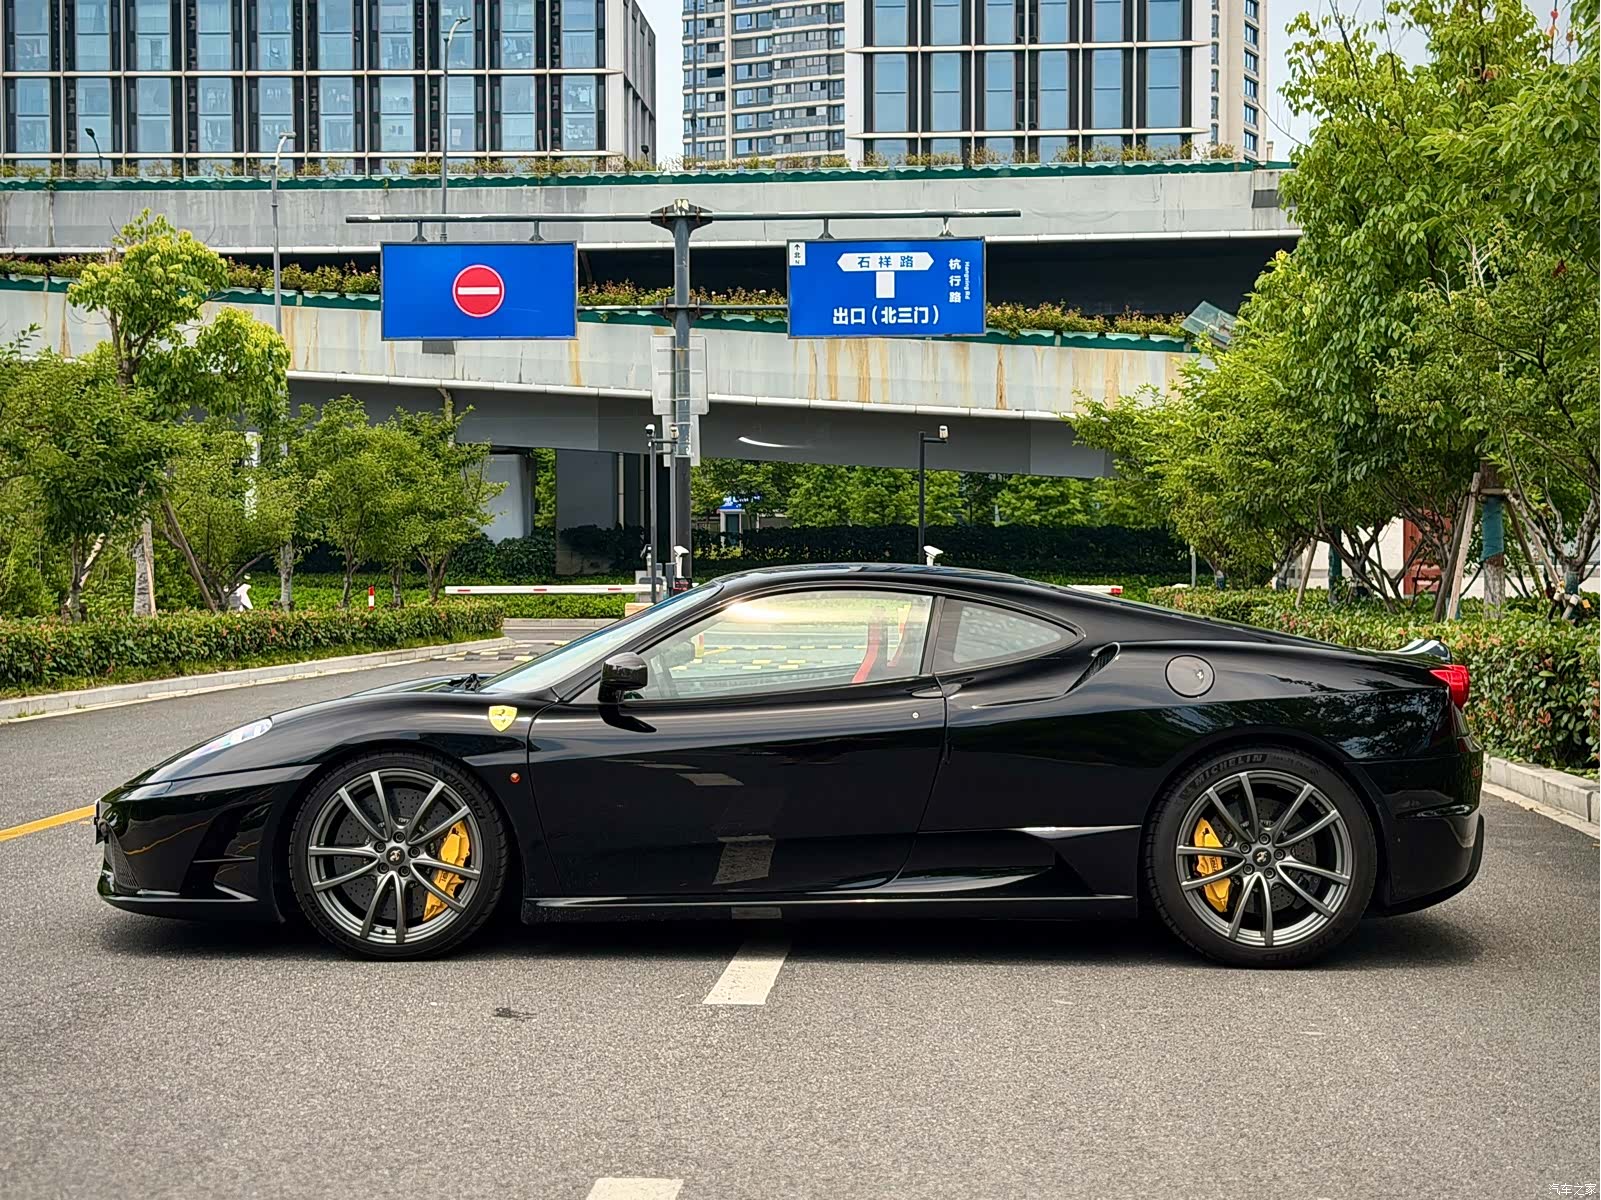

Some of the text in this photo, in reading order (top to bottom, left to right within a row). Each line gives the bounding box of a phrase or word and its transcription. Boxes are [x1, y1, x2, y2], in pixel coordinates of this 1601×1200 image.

[857, 255, 914, 268] 石祥路
[948, 258, 962, 303] 杭行路
[963, 261, 971, 300] Hangxing Rd
[832, 305, 940, 325] 出口（北三门）
[1194, 754, 1263, 785] MICHELIN
